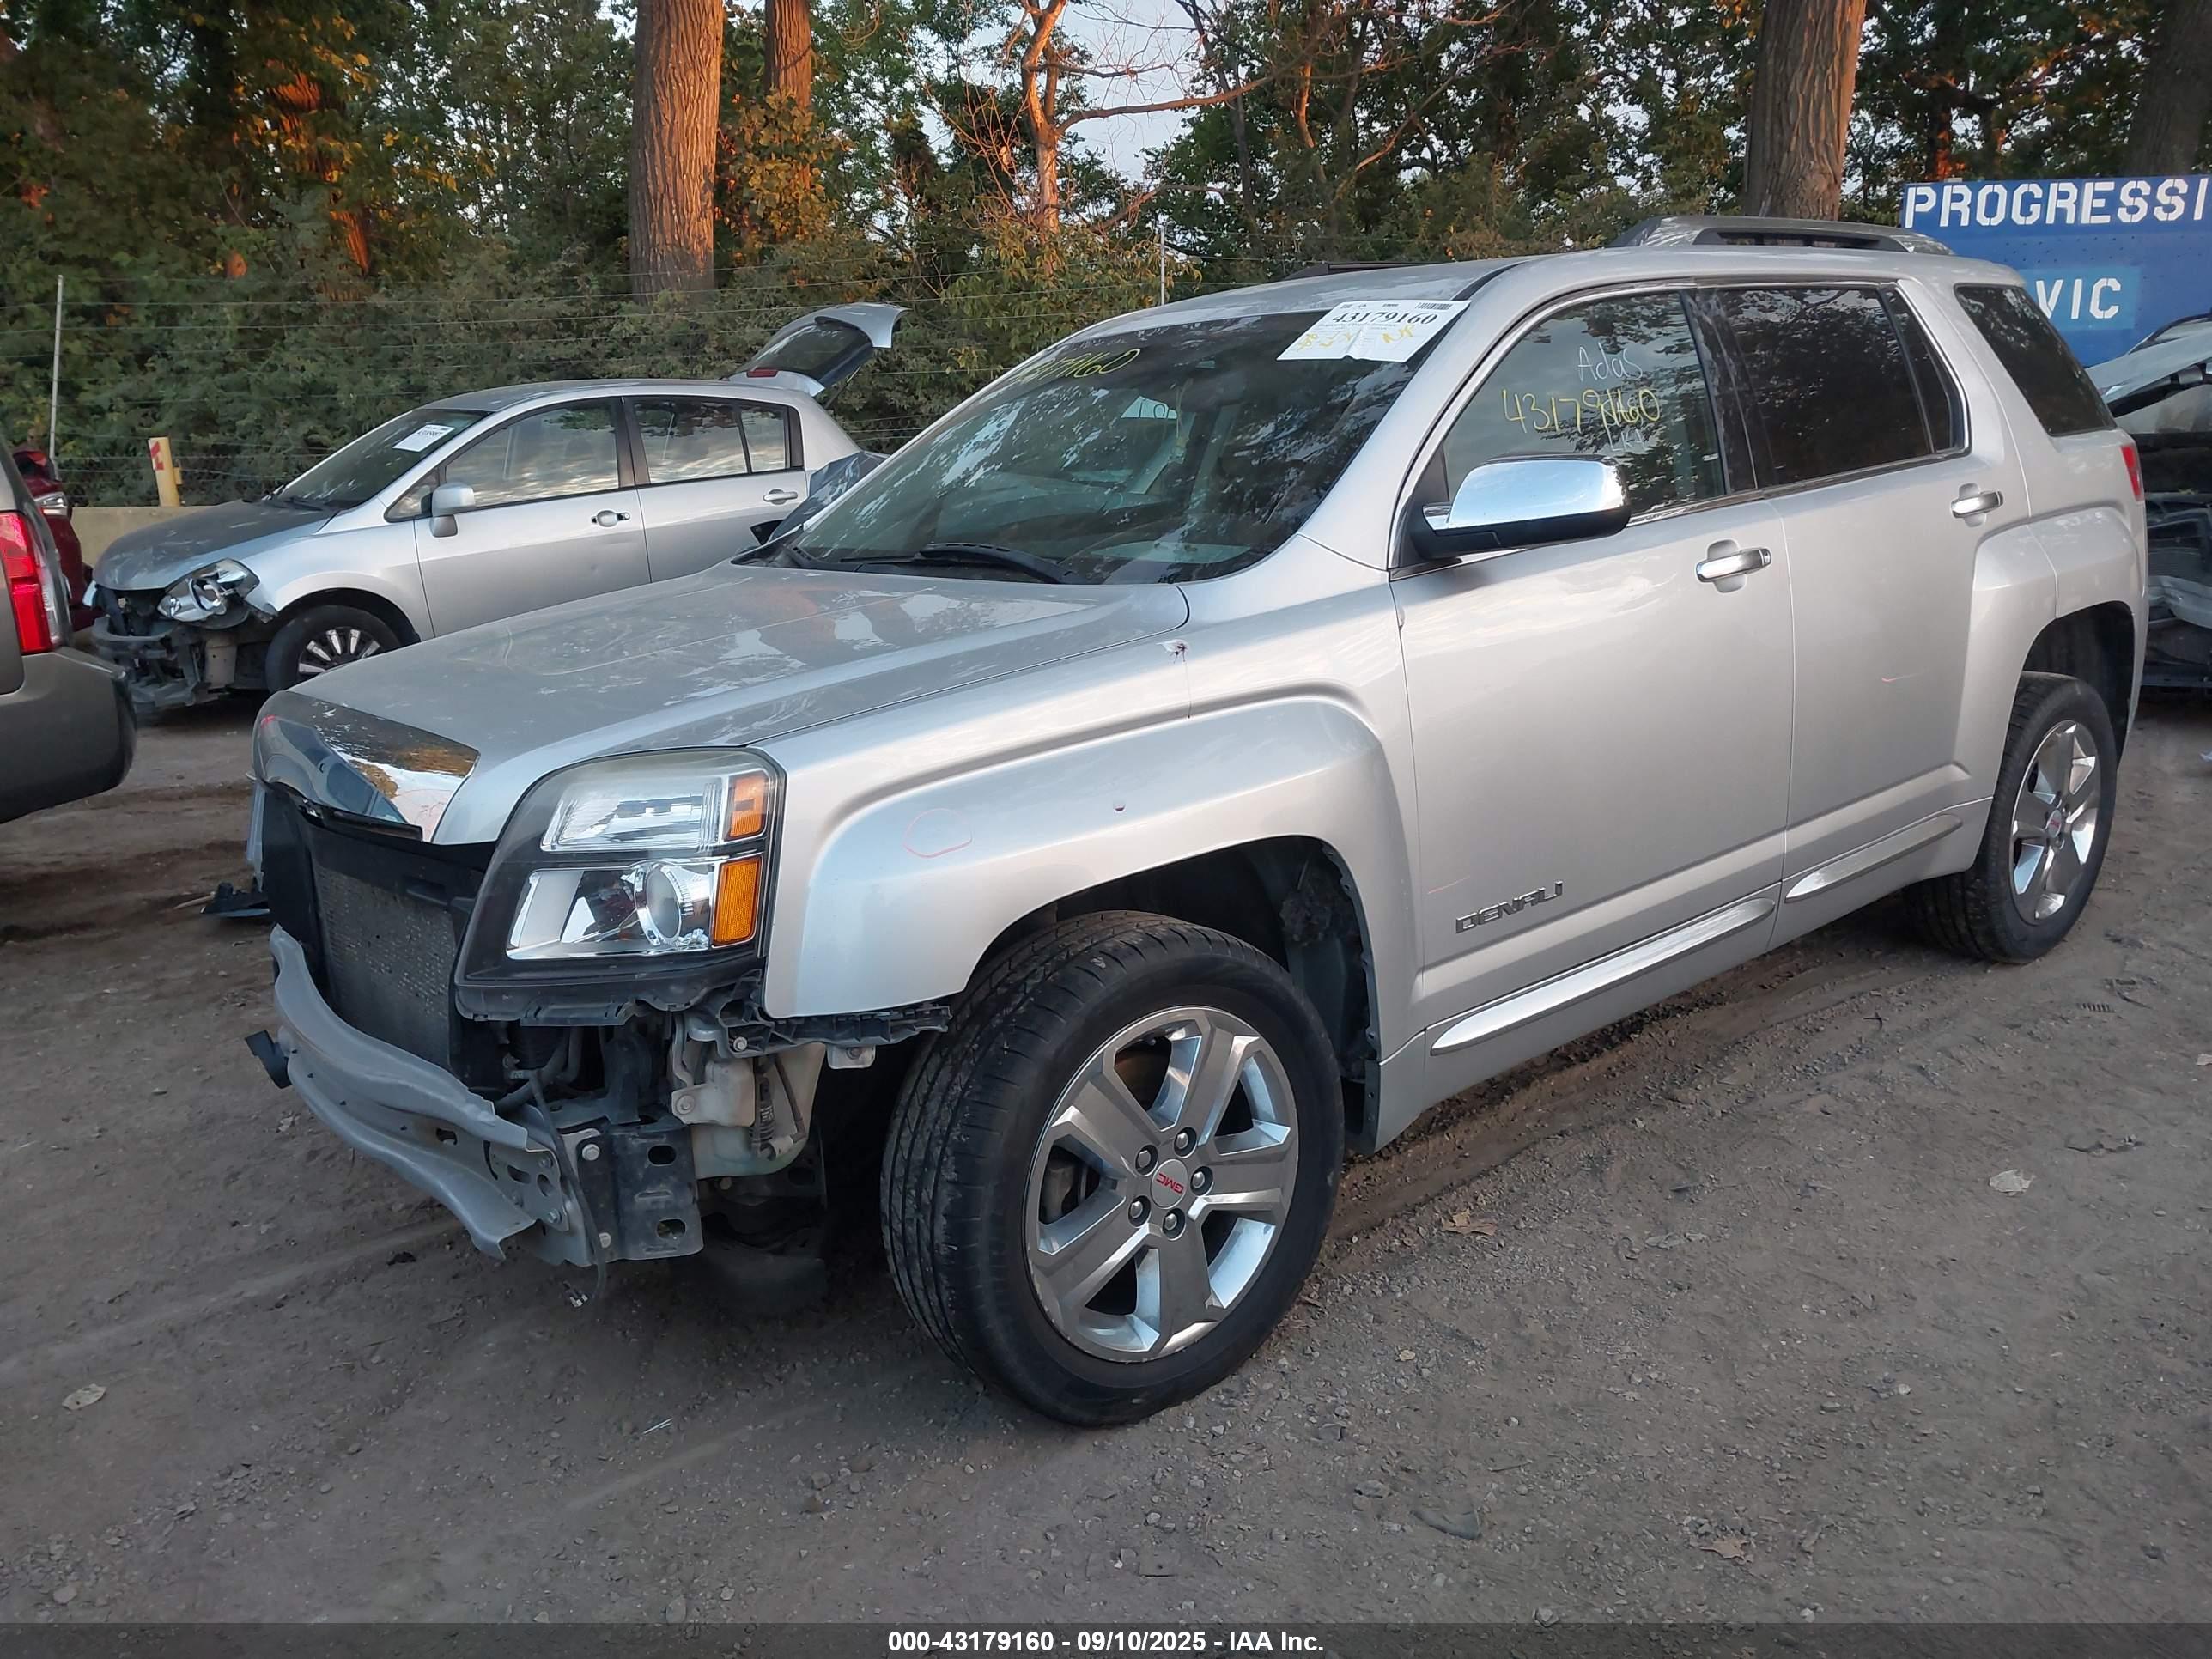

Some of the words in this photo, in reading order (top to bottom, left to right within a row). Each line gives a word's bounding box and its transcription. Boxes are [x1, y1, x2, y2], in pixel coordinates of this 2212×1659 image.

[1905, 177, 2209, 228] PROGRESSI
[1332, 311, 1438, 325] 43179160
[1455, 880, 1564, 934] DENALI
[1156, 1172, 1185, 1194] GMC
